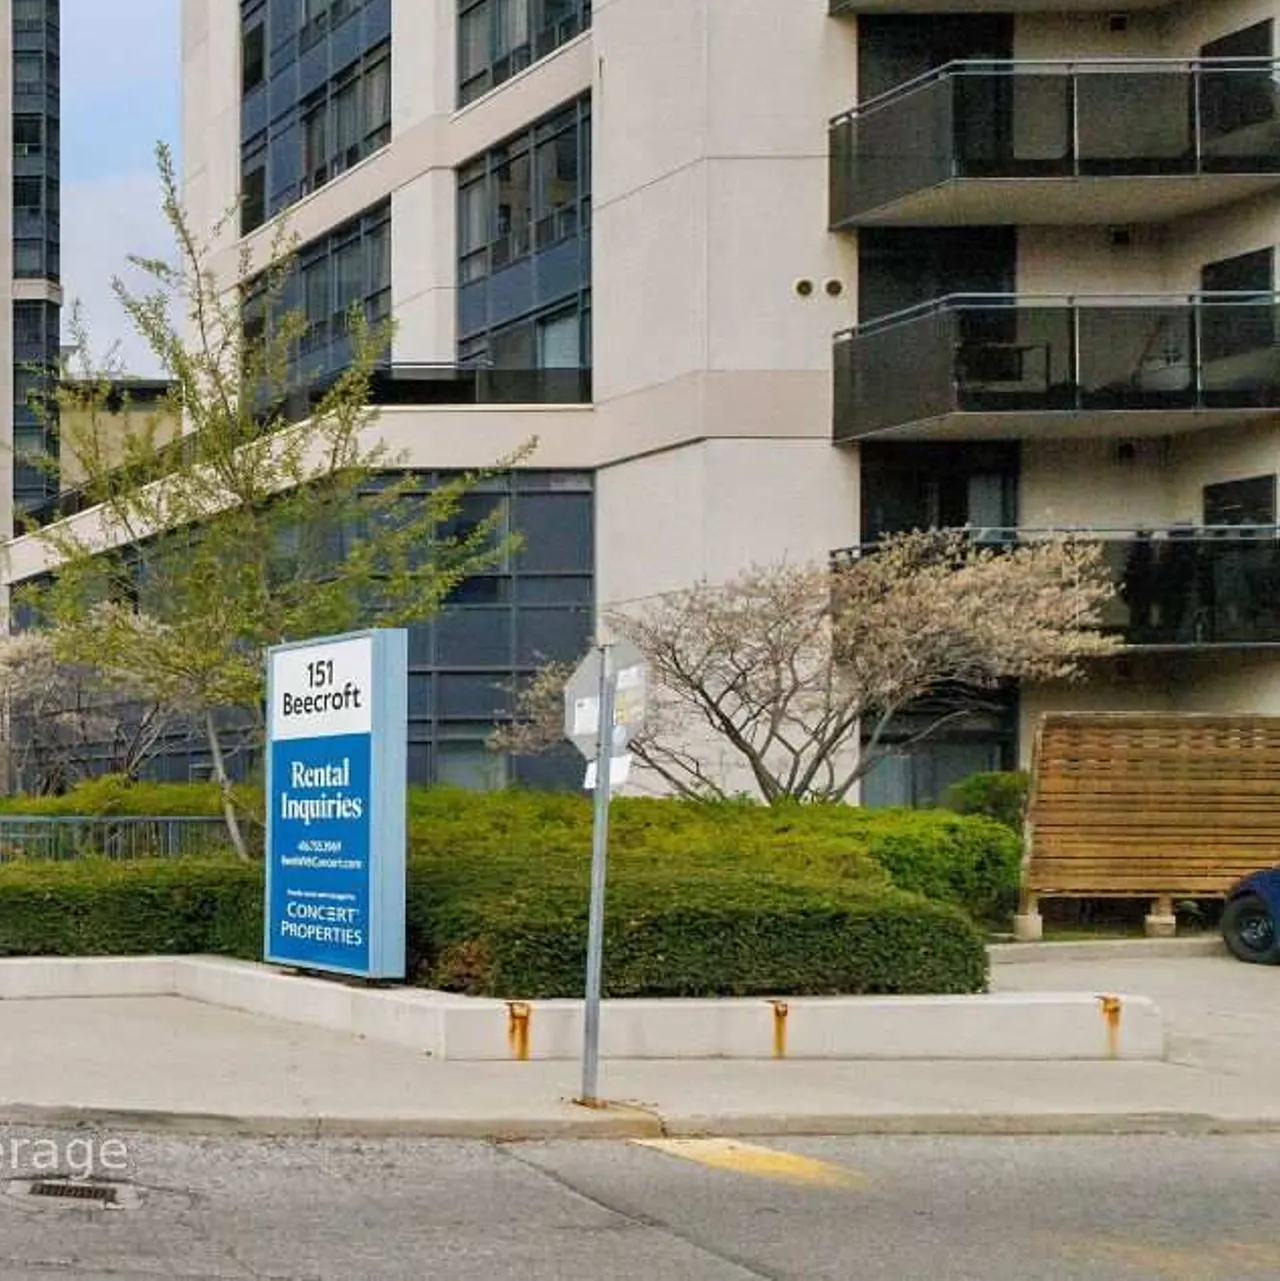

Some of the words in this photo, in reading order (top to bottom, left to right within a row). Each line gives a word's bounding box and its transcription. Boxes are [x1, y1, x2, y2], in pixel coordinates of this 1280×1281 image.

[307, 660, 333, 687] 151
[283, 682, 361, 715] Beecroft
[291, 757, 350, 788] Rental
[281, 792, 362, 826] Inquiries
[287, 901, 354, 922] CONCERT
[281, 920, 362, 945] PROPERTIES
